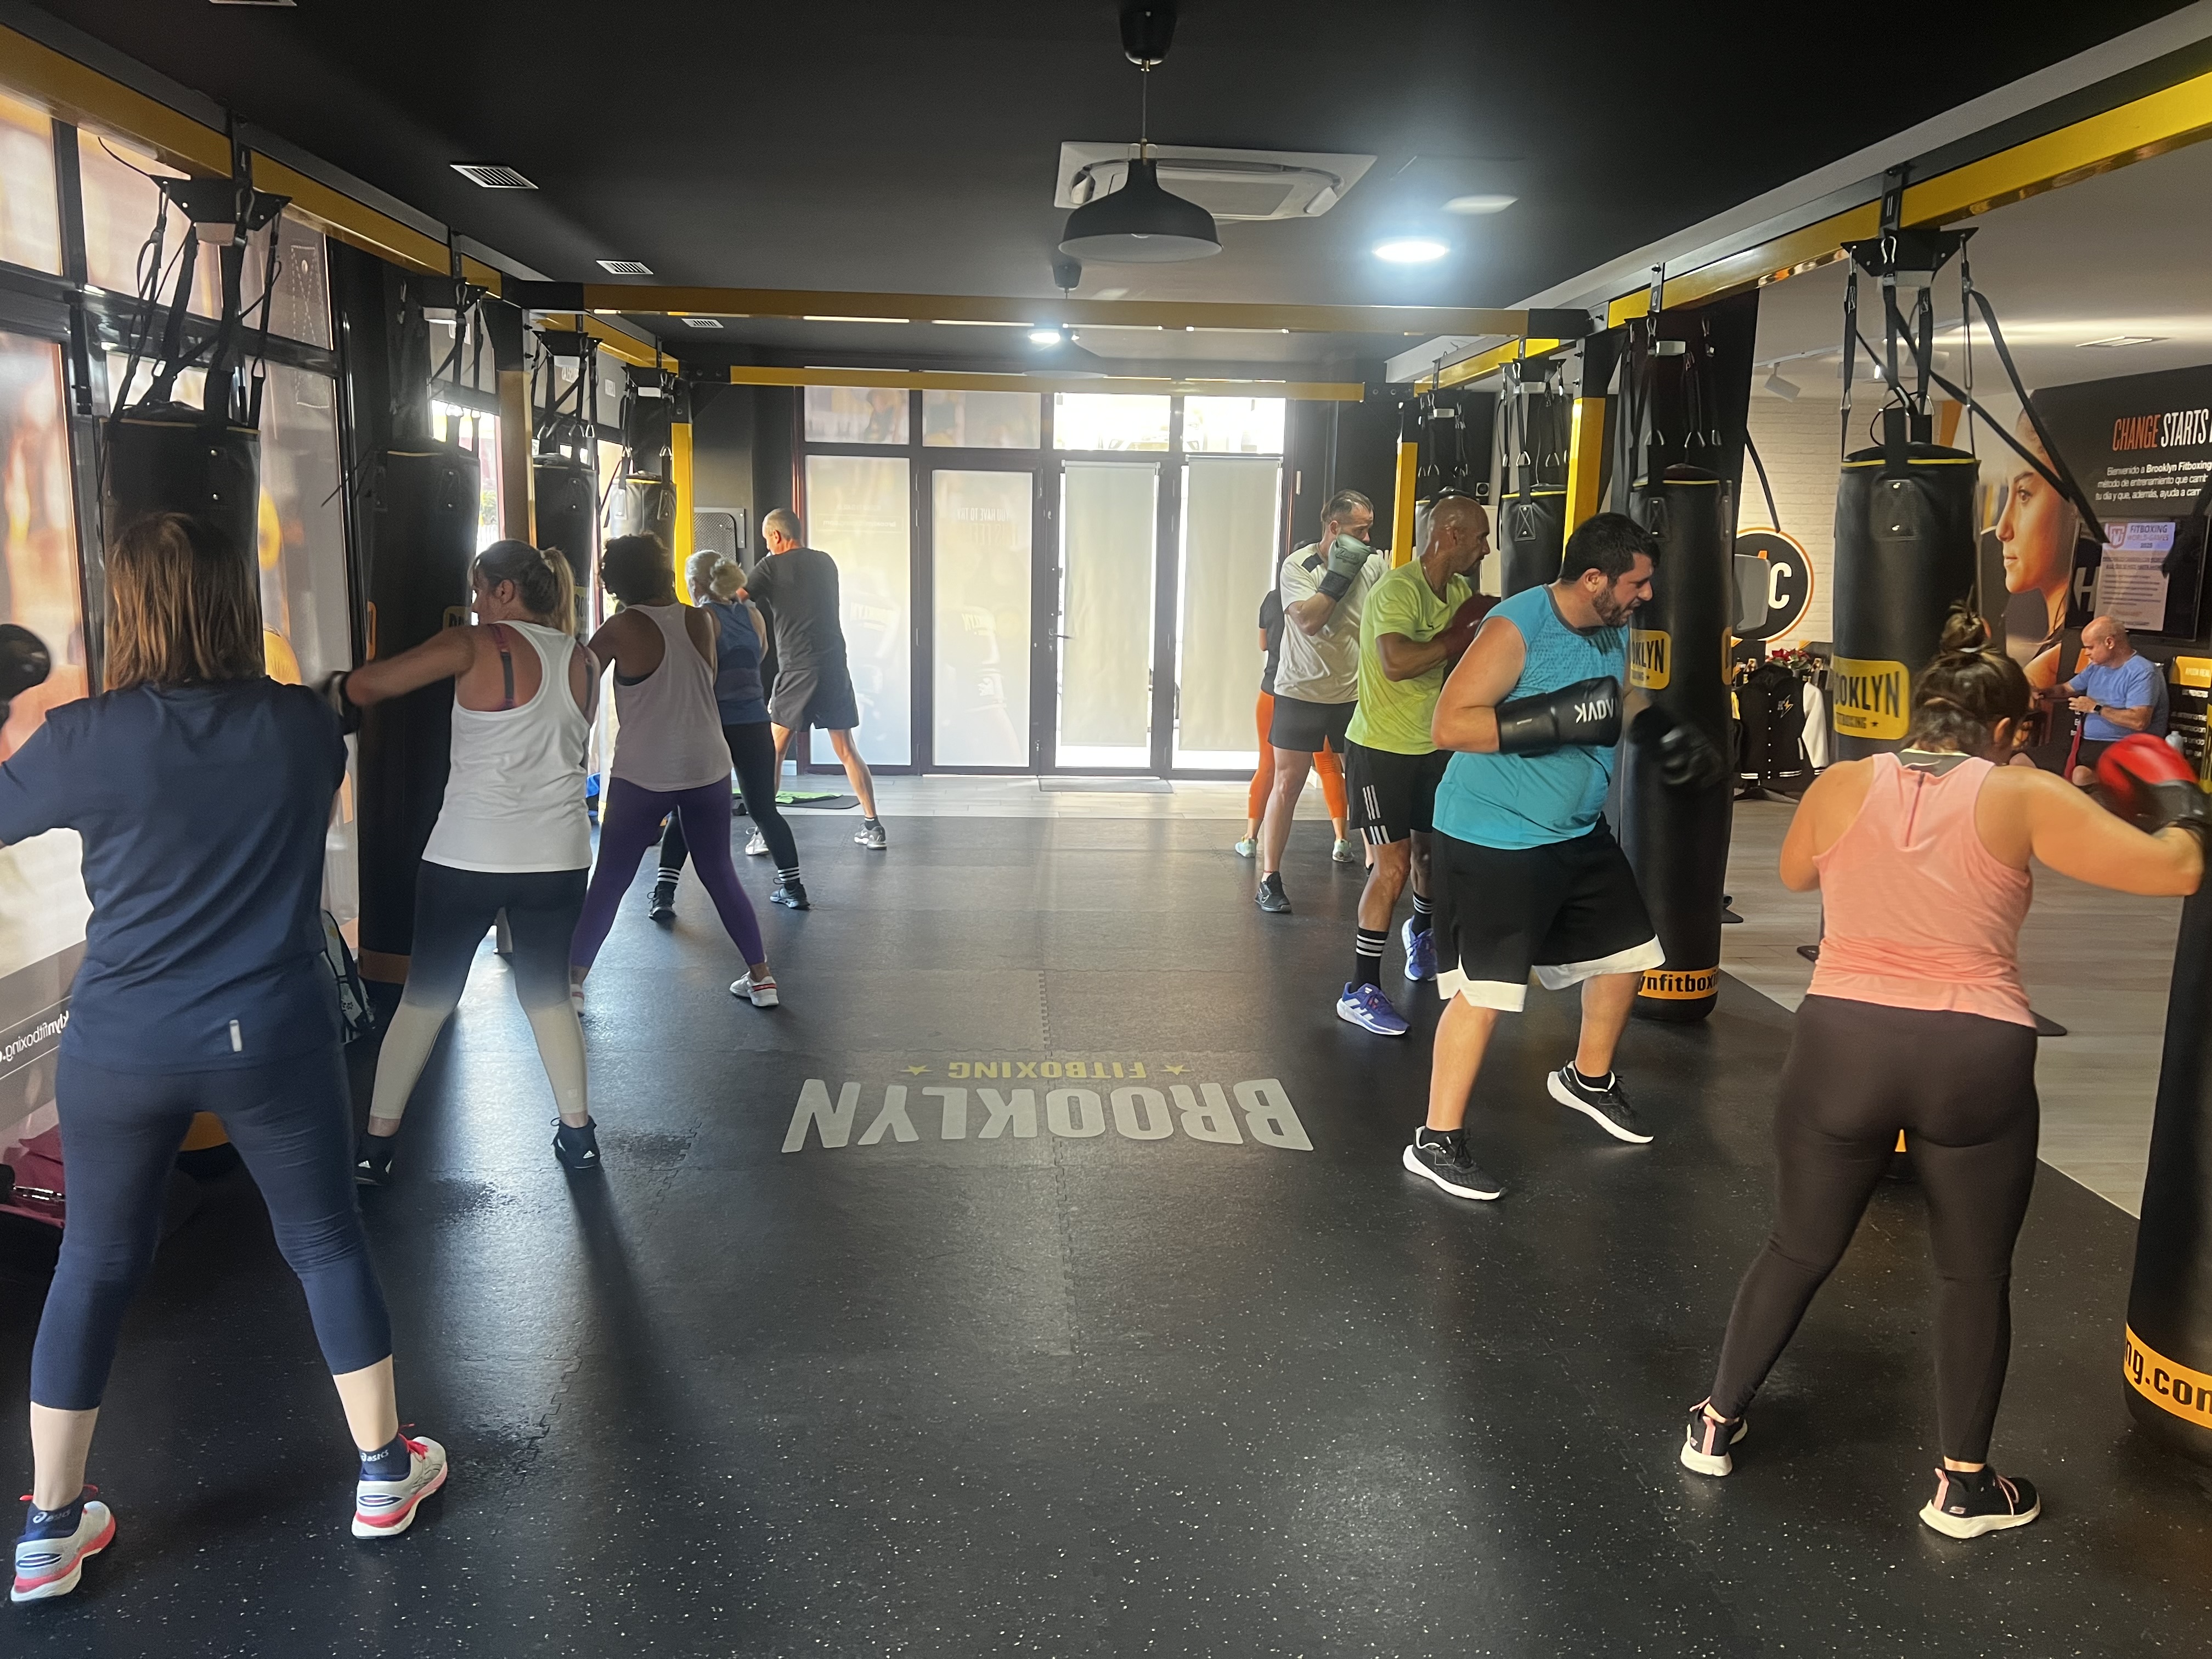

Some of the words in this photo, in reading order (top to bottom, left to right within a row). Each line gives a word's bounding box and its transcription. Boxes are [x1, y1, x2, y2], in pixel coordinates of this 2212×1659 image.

[2113, 414, 2161, 451] CHANGE
[2160, 408, 2209, 447] STARTS
[2146, 462, 2177, 473] Brooklyn
[2121, 478, 2129, 487] de
[2175, 476, 2188, 486] que
[2159, 488, 2180, 499] ayuda
[2130, 524, 2168, 533] FITBOXING
[949, 1061, 1147, 1079] FITBOXING
[781, 1078, 1314, 1153] BROOKLYN
